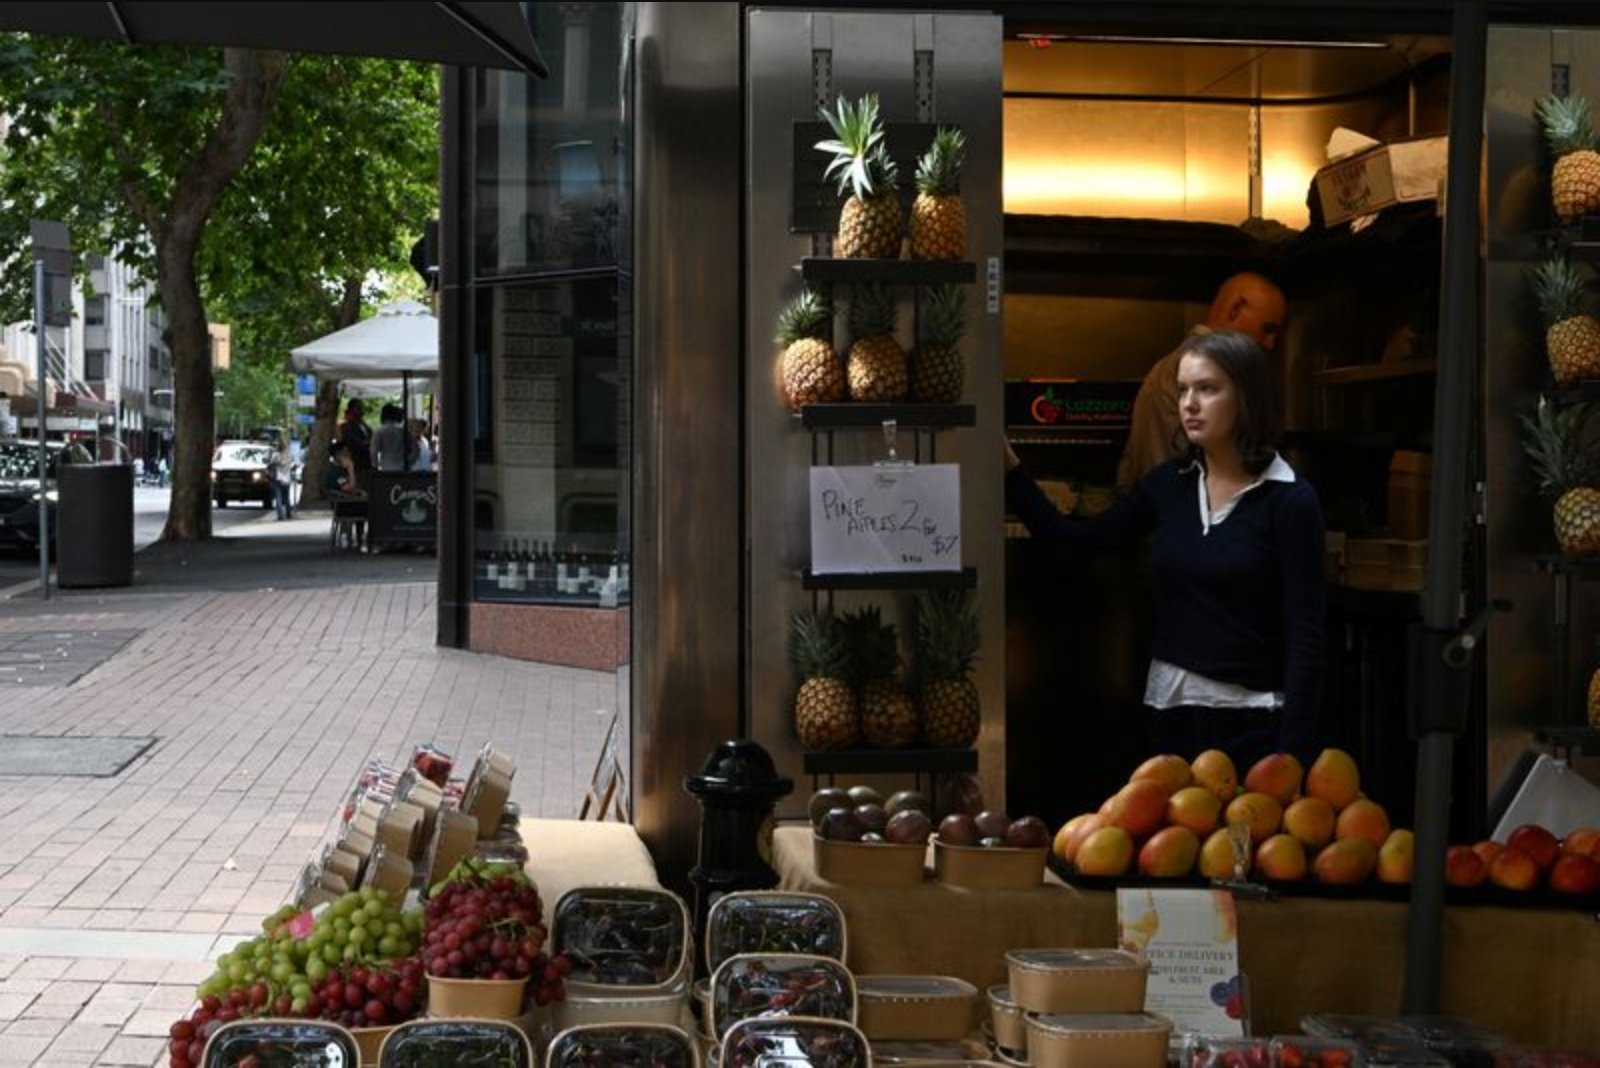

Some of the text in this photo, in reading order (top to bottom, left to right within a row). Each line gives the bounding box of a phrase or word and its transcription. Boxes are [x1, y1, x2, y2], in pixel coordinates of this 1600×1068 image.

[821, 490, 865, 520] PINE
[899, 499, 921, 533] 2
[1179, 950, 1233, 961] DELIVERY
